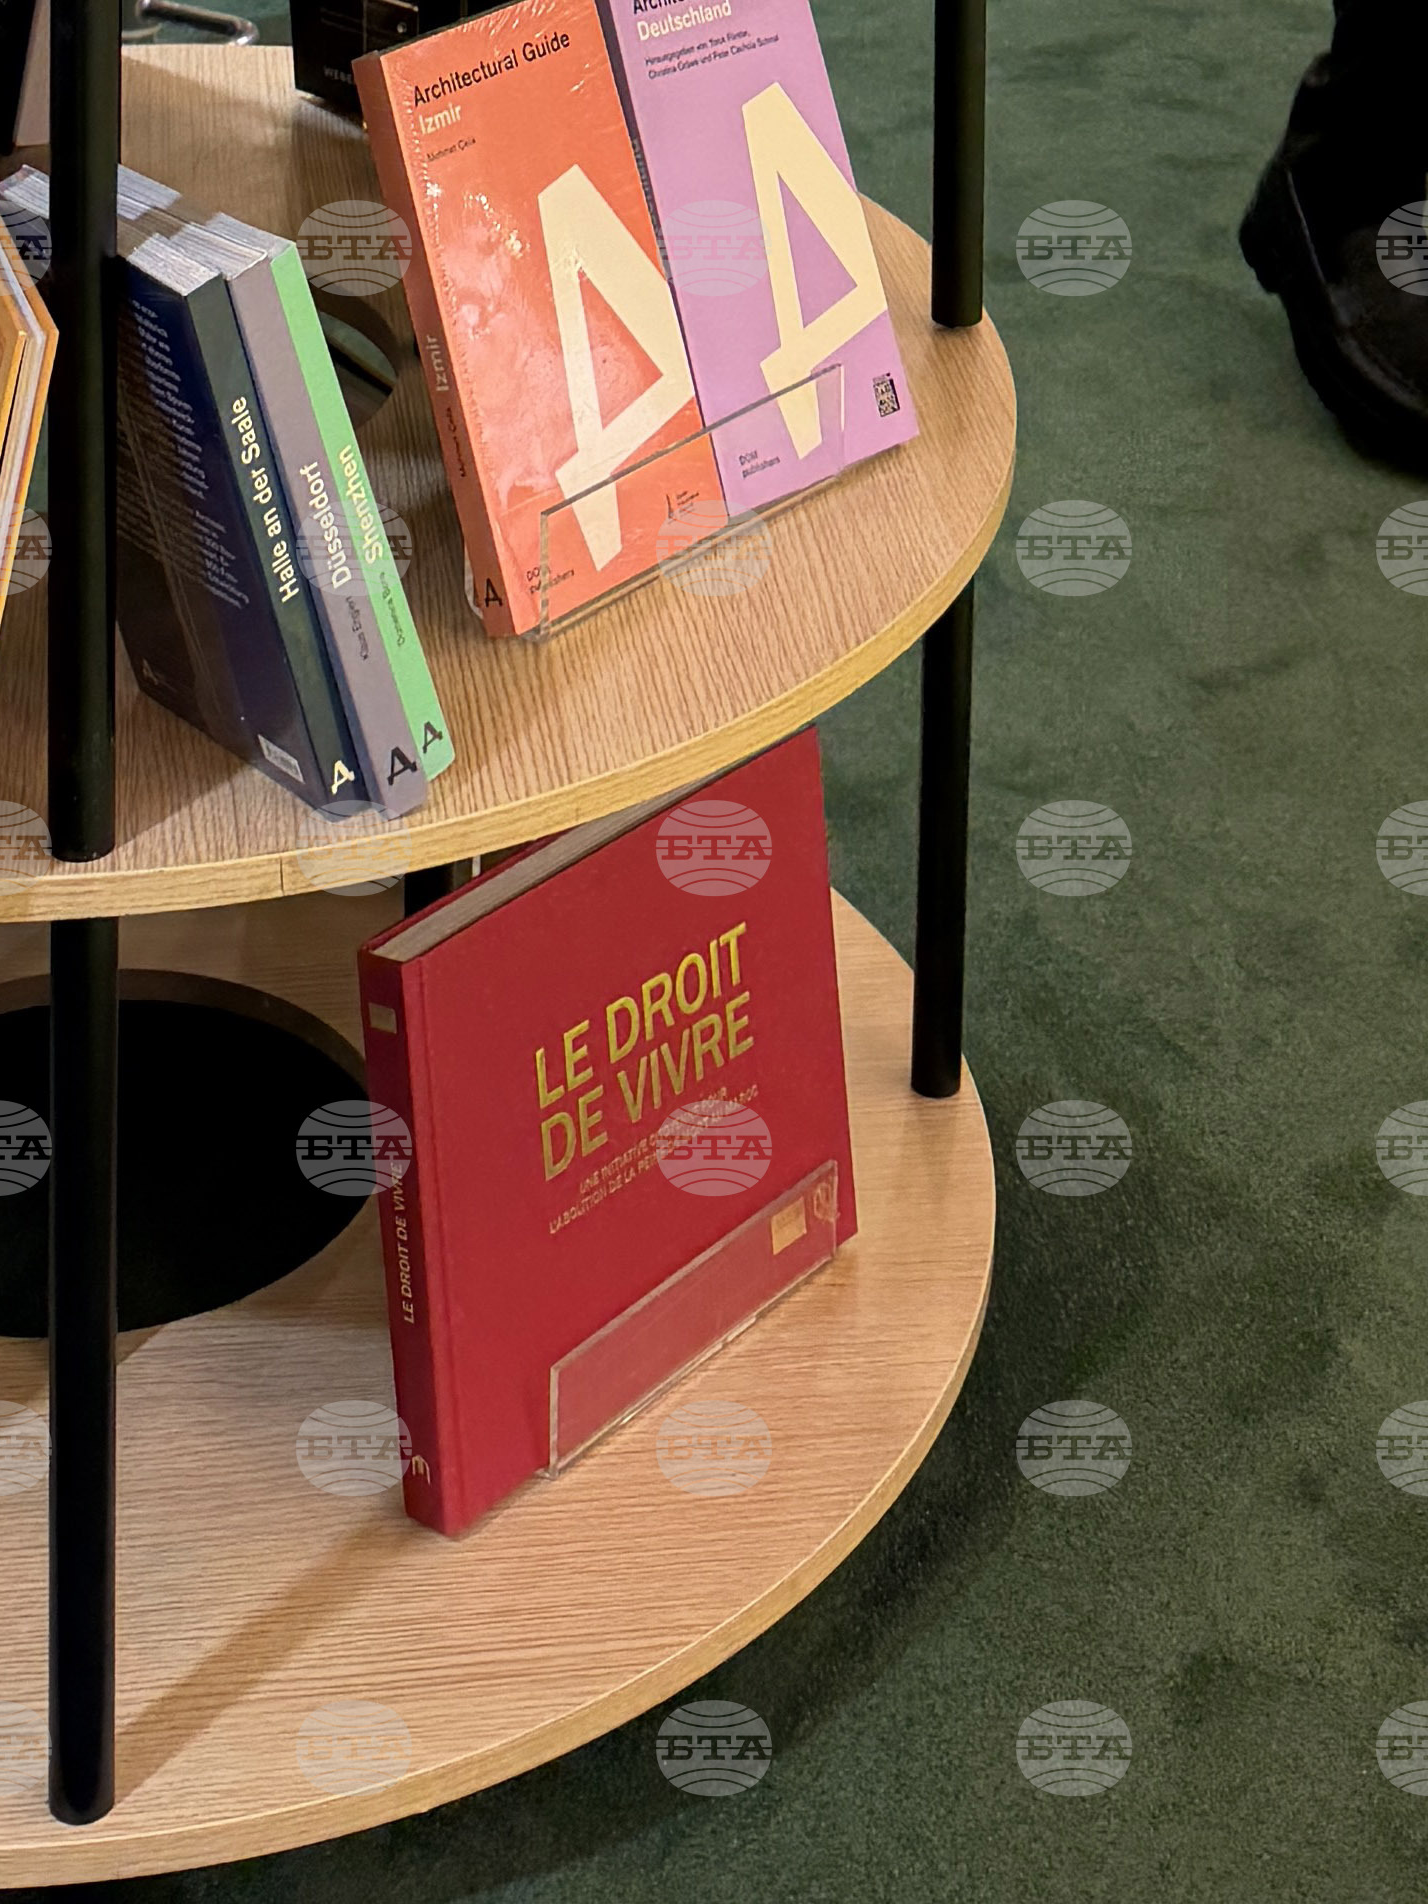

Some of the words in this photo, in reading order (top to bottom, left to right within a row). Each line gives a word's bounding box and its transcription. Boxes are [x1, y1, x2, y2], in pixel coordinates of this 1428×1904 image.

[414, 48, 519, 108] Architectural
[522, 31, 571, 63] Guide
[418, 101, 462, 136] Izmir
[426, 334, 450, 392] Izmir
[231, 395, 261, 466] Saale
[251, 466, 273, 505] der
[337, 443, 384, 566] Shenzhen
[262, 506, 283, 538] an
[299, 460, 353, 590] Düsseldorf
[271, 539, 300, 603] Halle
[535, 1019, 595, 1110] LE
[605, 920, 748, 1065] DROIT
[540, 1084, 609, 1182] DE
[616, 990, 756, 1124] VIVRE
[390, 1160, 406, 1213] VIVRE
[395, 1214, 408, 1240] DE
[397, 1241, 413, 1296] DROIT
[402, 1301, 414, 1325] LE
